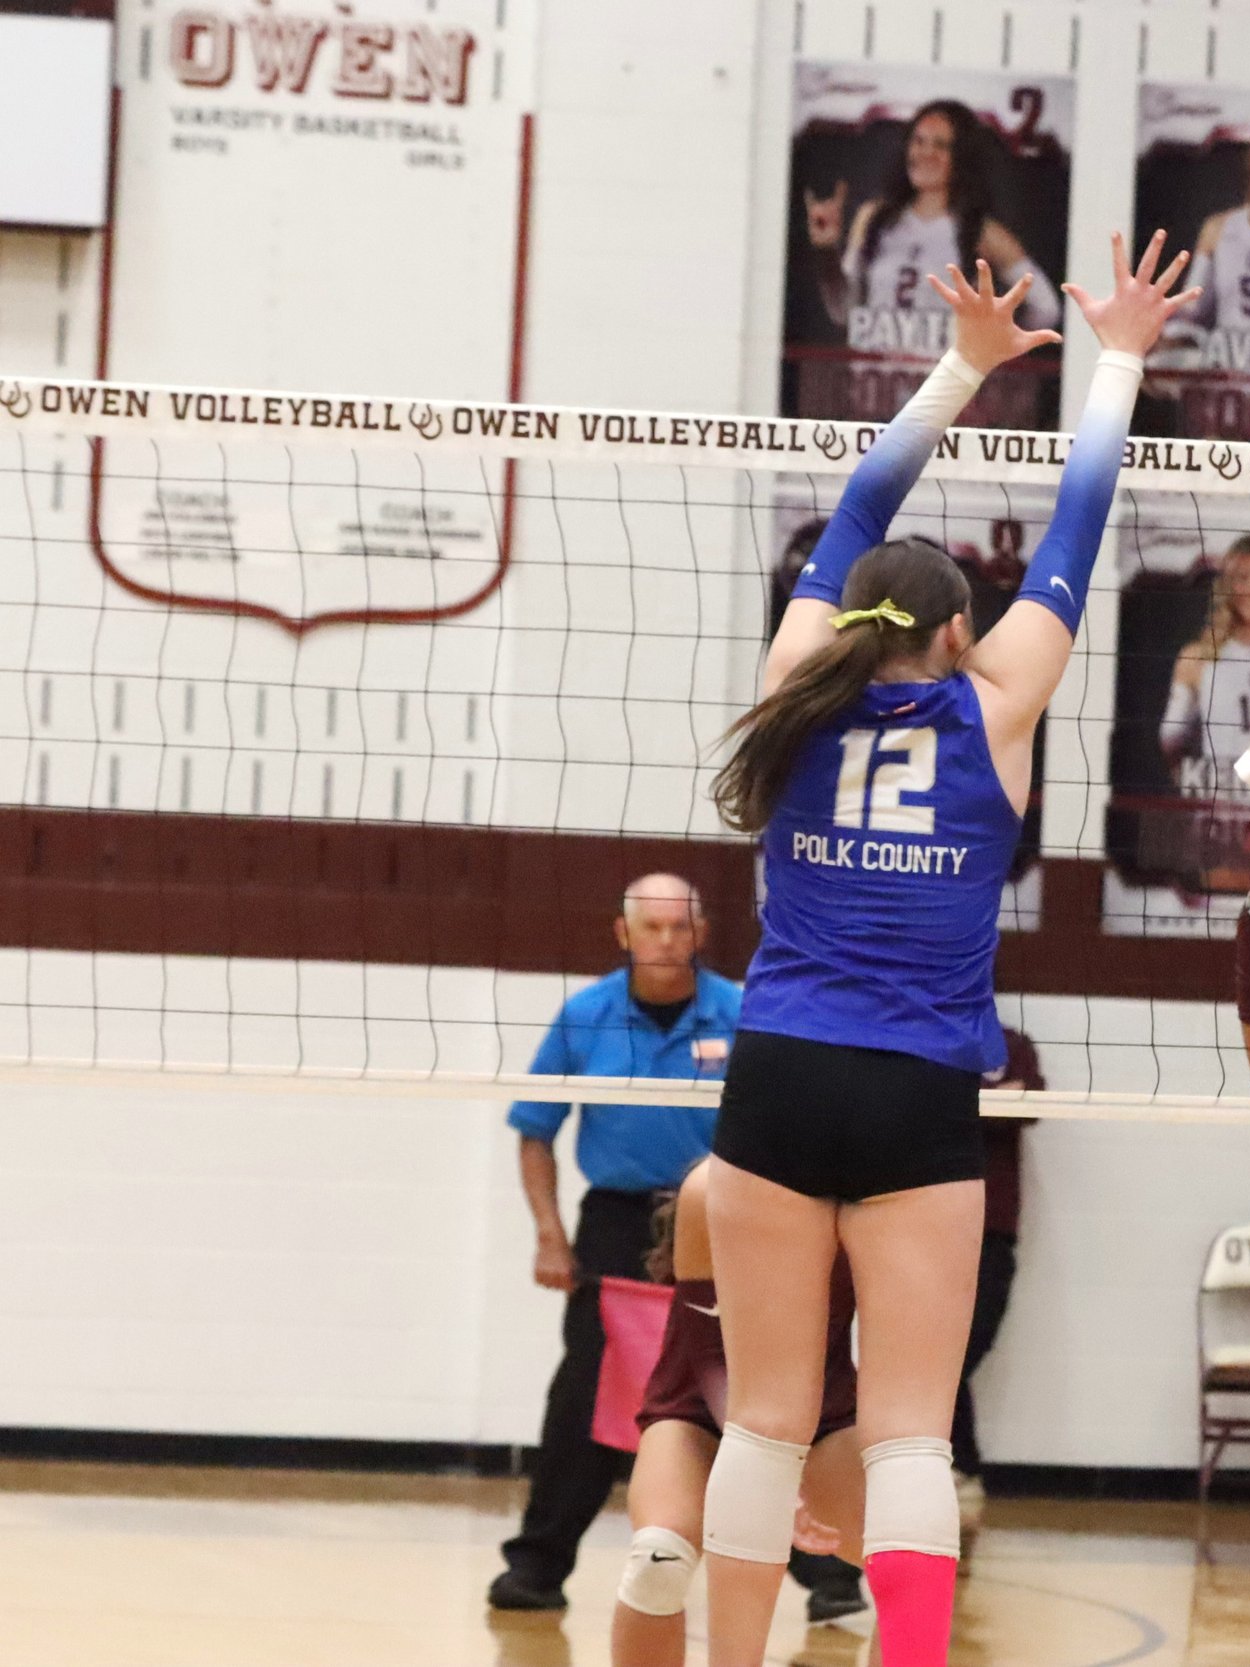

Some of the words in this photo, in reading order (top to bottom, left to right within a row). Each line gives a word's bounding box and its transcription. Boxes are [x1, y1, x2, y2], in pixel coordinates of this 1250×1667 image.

[171, 11, 476, 106] OWEN
[171, 106, 283, 129] VARSITY
[295, 114, 462, 145] BASKETBALL
[1009, 86, 1045, 152] 2
[41, 385, 150, 417] OWEN
[170, 392, 401, 430] VOLLEYBALL
[453, 407, 559, 439] OWEN
[579, 414, 806, 451] VOLLEYBALL
[857, 428, 960, 459] ON
[978, 434, 1201, 471] VOLLBALL
[833, 726, 938, 835] 12
[793, 832, 855, 868] POLK
[862, 841, 967, 874] COUNTY
